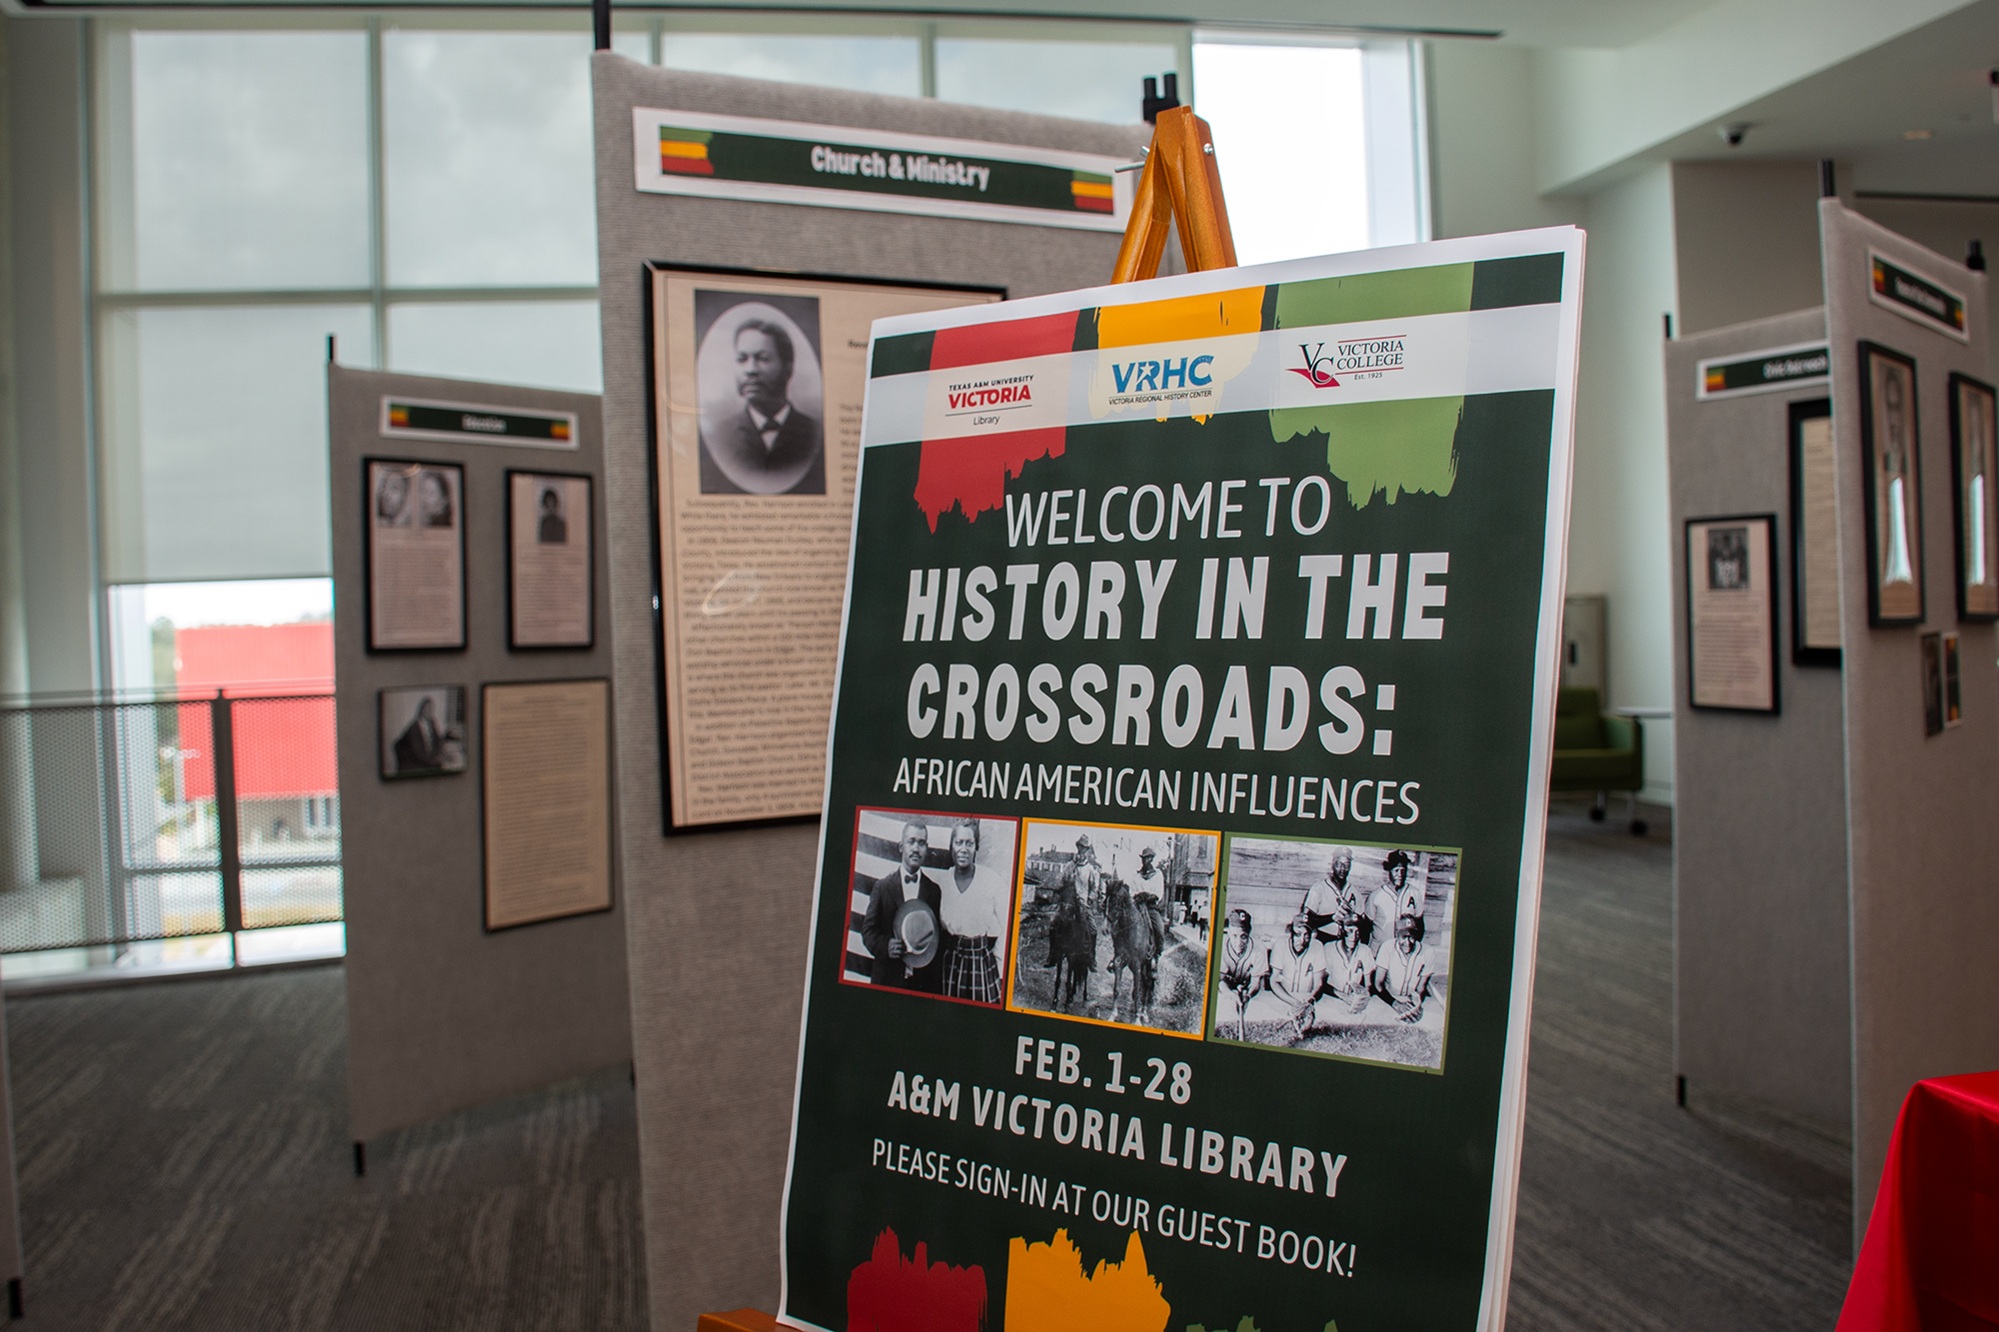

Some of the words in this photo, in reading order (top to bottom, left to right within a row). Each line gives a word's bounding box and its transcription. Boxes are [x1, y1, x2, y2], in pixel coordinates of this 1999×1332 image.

[811, 145, 886, 178] Church
[888, 153, 905, 180] &
[906, 154, 990, 192] Ministry
[1336, 353, 1403, 370] COLLEGE
[1337, 340, 1404, 356] VICTORIA
[948, 384, 1032, 409] VICTORIA
[949, 382, 972, 391] TEXAS
[974, 380, 989, 389] A&M
[990, 375, 1034, 386] UNIVERSITY
[1108, 395, 1135, 405] VICTORIA
[1135, 393, 1163, 403] REGIONAL
[1164, 391, 1188, 401] HISTORY
[1189, 390, 1212, 400] CENTER
[1112, 354, 1215, 394] VRHC
[973, 415, 1001, 426] Library
[1006, 479, 1247, 548] WELCOME
[1260, 475, 1331, 537] TO
[902, 558, 1177, 643] HISTORY
[1195, 555, 1270, 640] IN
[1298, 551, 1450, 640] THE
[906, 662, 1396, 757] CROSSROADS:
[892, 757, 1010, 800] AFRICAN
[1013, 762, 1182, 811] AMERICAN
[1190, 771, 1421, 826] INFLUENCES
[1015, 1034, 1092, 1088] FEB.
[1105, 1051, 1192, 1105] 1-28
[887, 1070, 961, 1121] A&M
[972, 1085, 1146, 1161] VICTORIA
[1160, 1122, 1348, 1198] LIBRARY
[873, 1138, 950, 1185] PLEASE
[955, 1158, 1047, 1208] SIGN-IN
[1052, 1180, 1087, 1216] AT
[1092, 1189, 1150, 1232] OUR
[1157, 1204, 1251, 1254] GUEST
[1257, 1224, 1357, 1278] BOOK!
